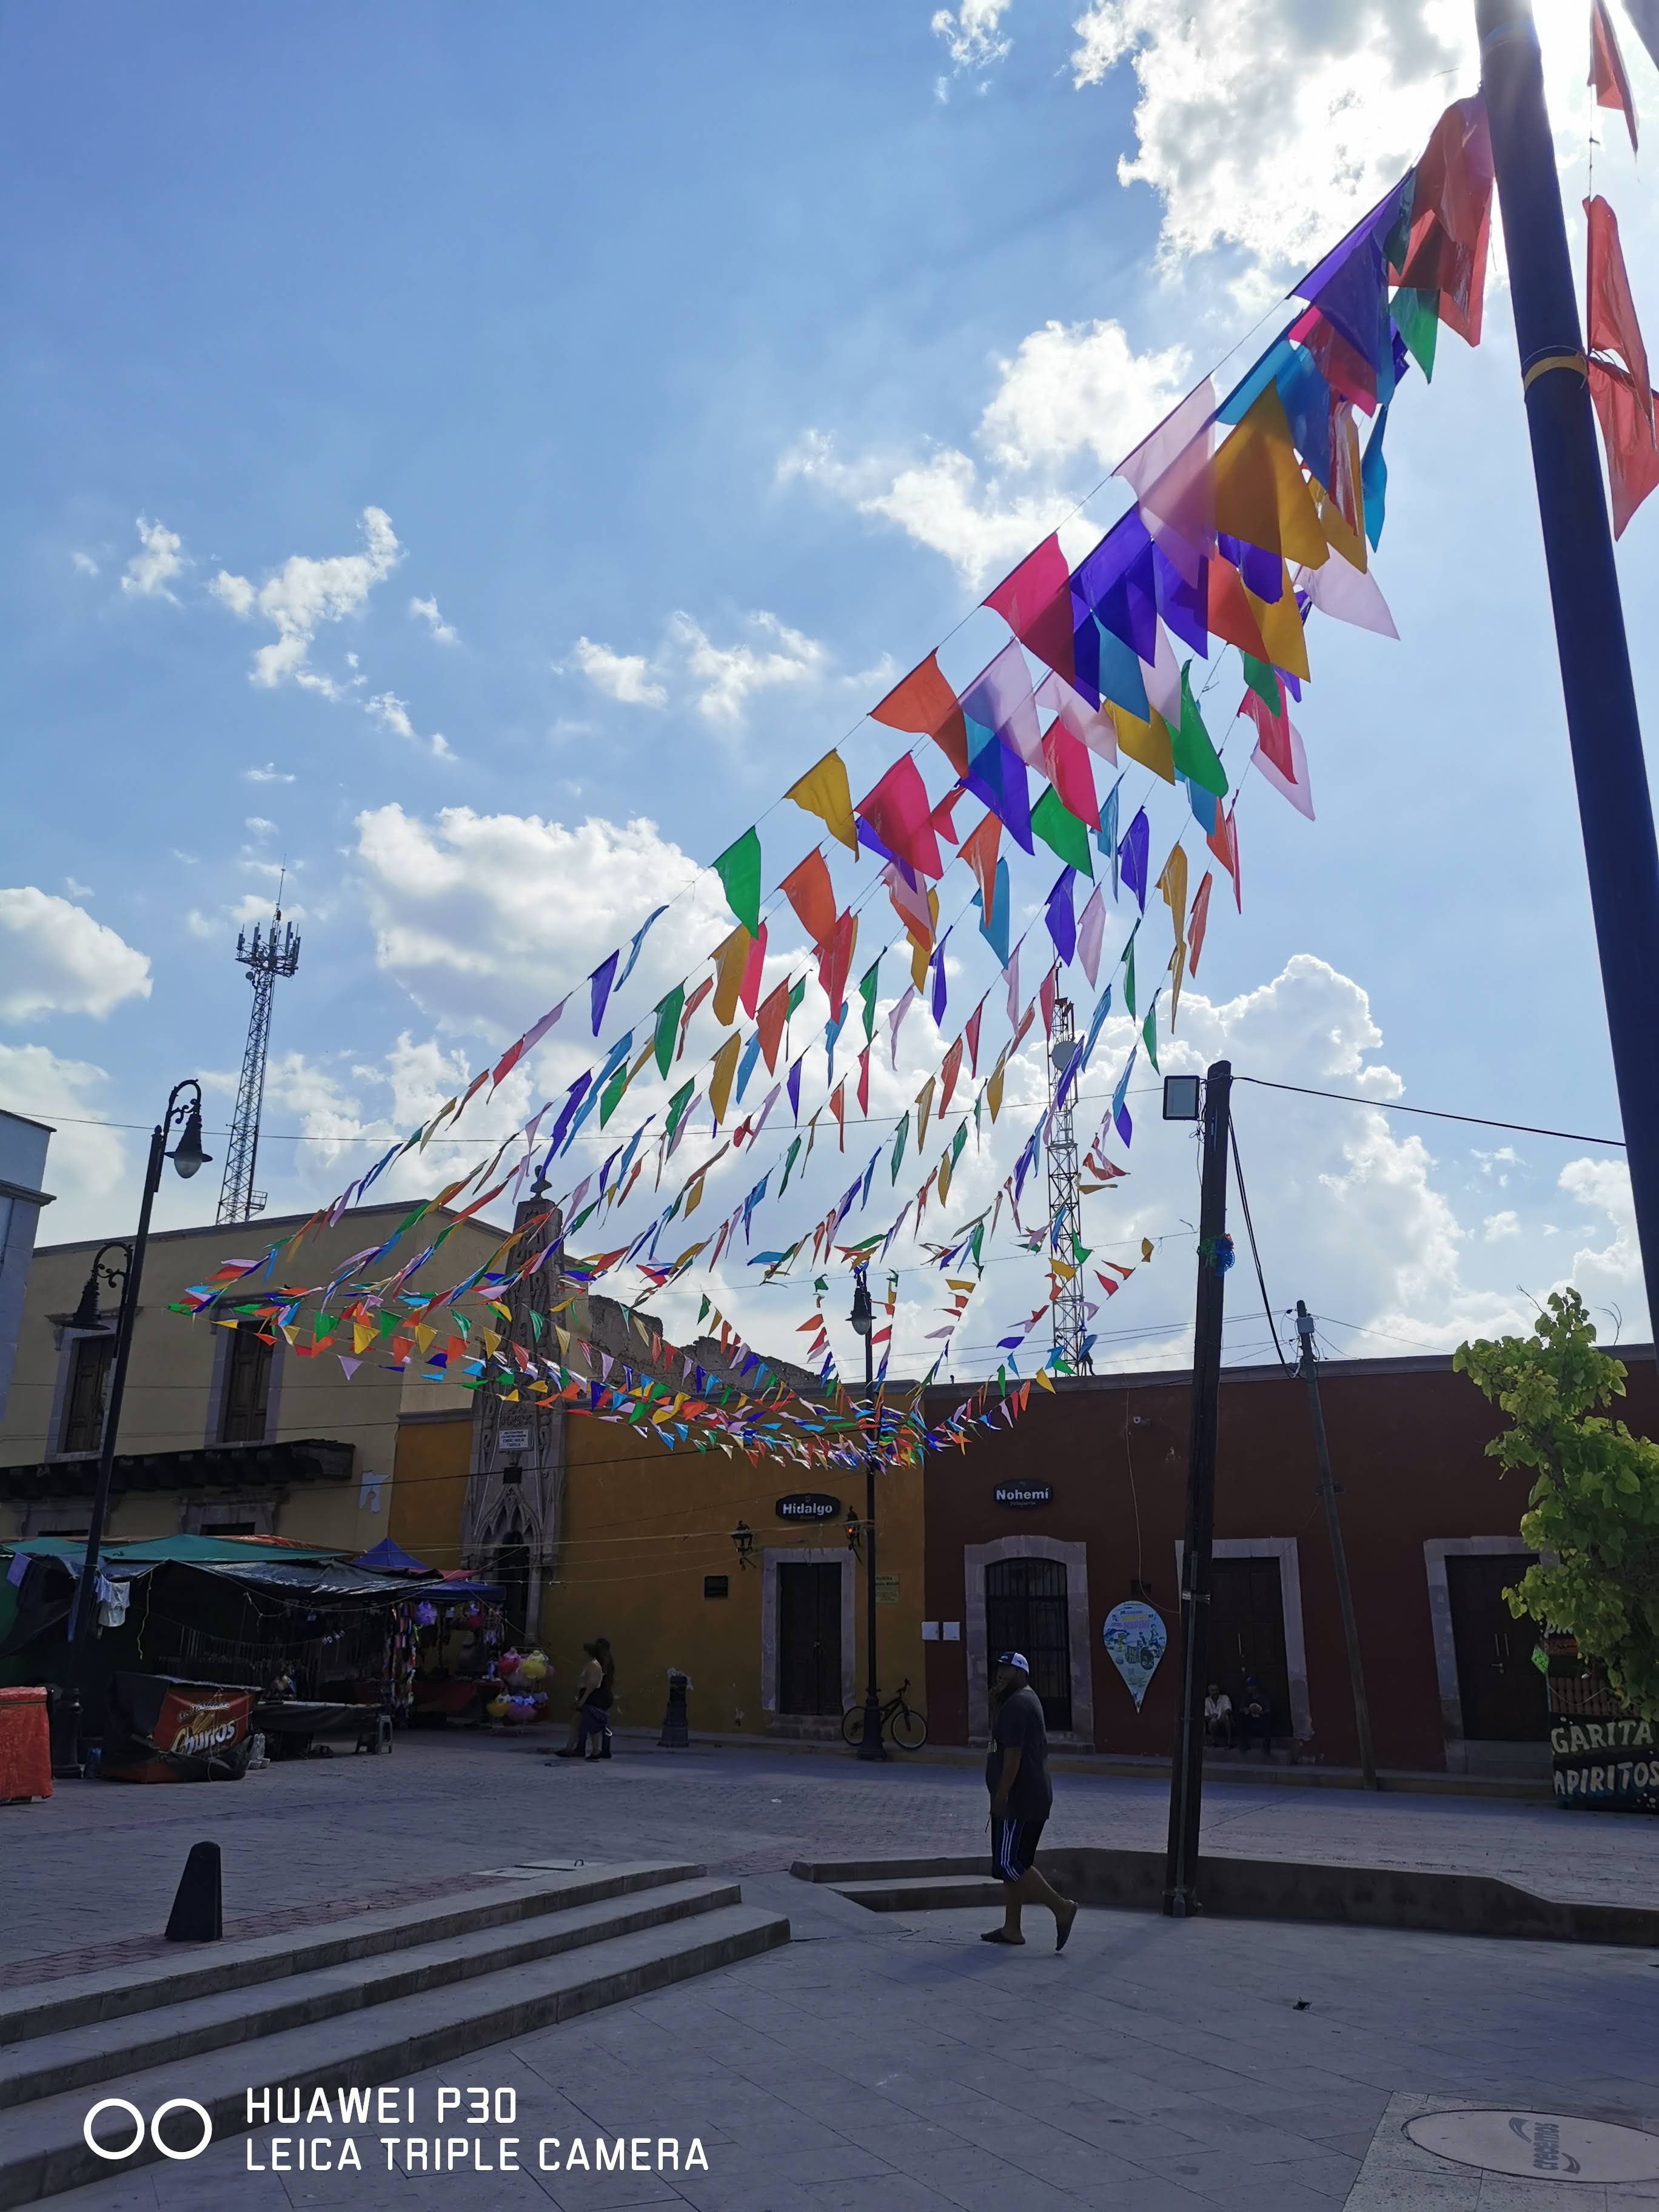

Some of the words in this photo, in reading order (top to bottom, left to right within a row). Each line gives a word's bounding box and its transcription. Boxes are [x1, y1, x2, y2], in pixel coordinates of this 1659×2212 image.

[783, 1503, 833, 1516] Hidalgo
[996, 1487, 1049, 1500] Nohemí
[170, 1721, 236, 1757] Churros
[1551, 1720, 1654, 1755] GARITA
[1533, 2122, 1560, 2171] crecemos
